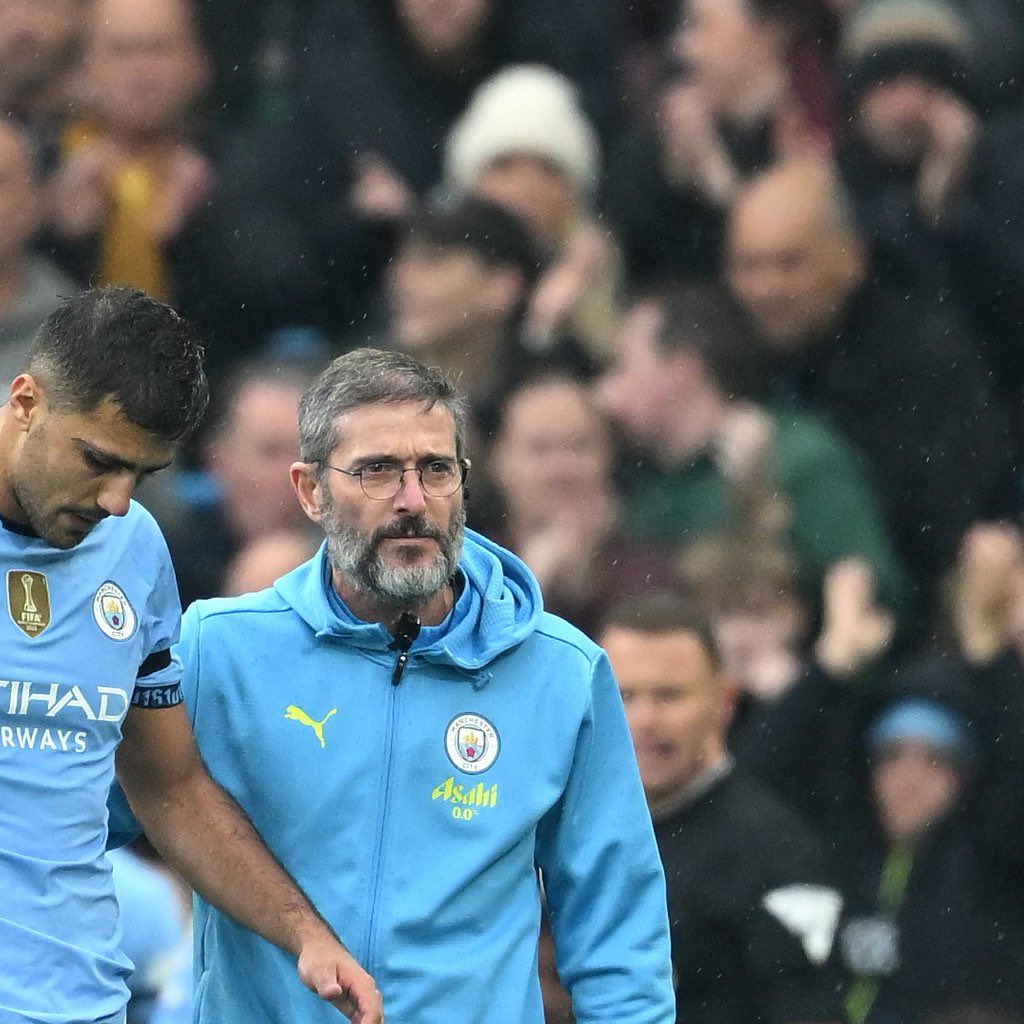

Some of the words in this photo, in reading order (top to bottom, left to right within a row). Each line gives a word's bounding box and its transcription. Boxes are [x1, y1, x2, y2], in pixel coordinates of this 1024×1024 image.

[21, 612, 41, 622] FIFA
[451, 717, 494, 738] MANCHESTER
[432, 776, 498, 808] Asahi
